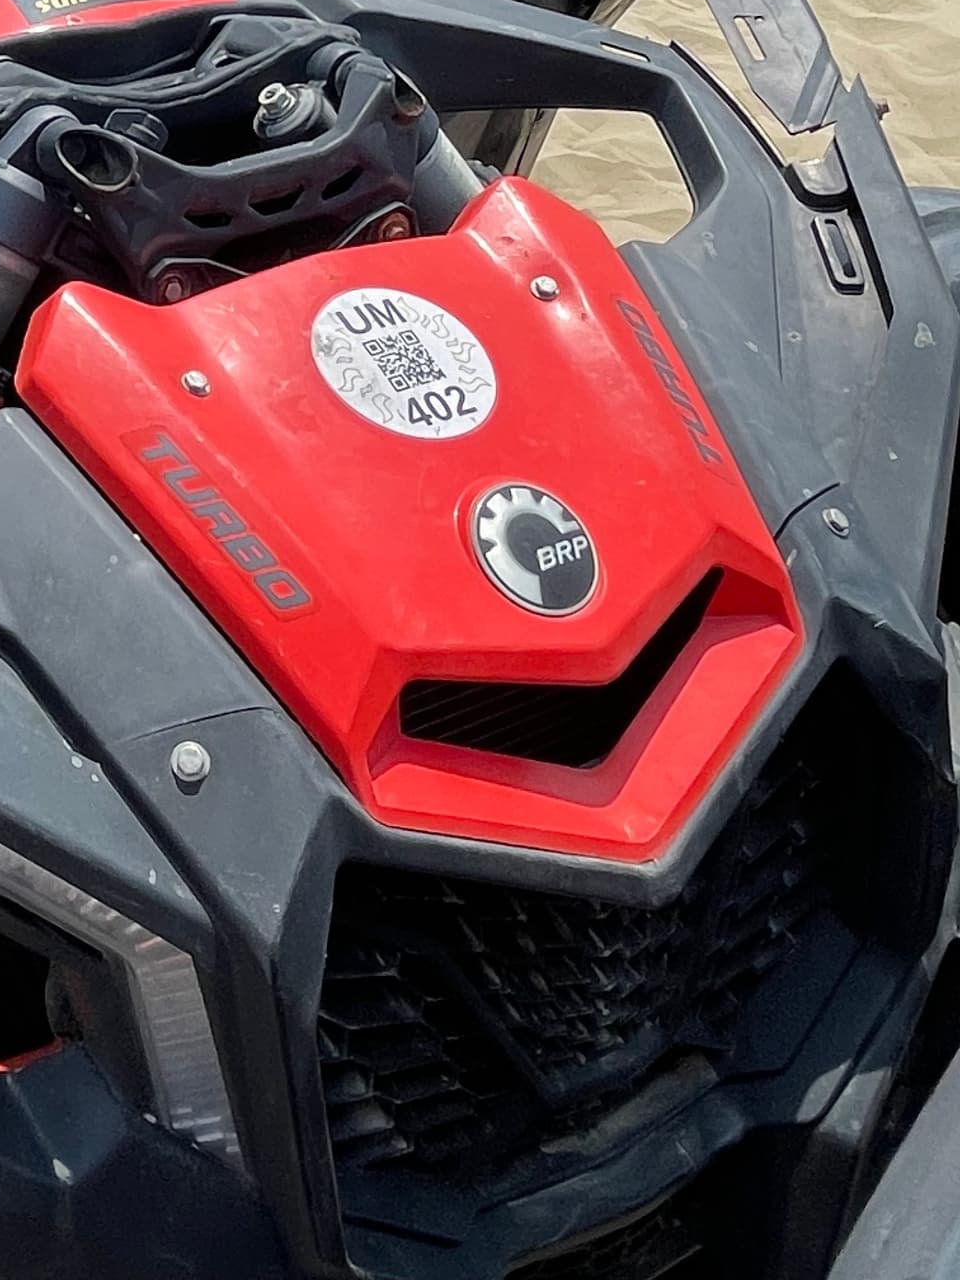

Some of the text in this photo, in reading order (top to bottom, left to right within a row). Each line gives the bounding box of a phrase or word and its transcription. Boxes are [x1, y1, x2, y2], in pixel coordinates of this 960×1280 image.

[336, 298, 408, 334] UM
[615, 299, 724, 463] TURBO
[407, 385, 478, 426] 402
[141, 431, 312, 610] TURBO
[536, 535, 588, 571] BRP
